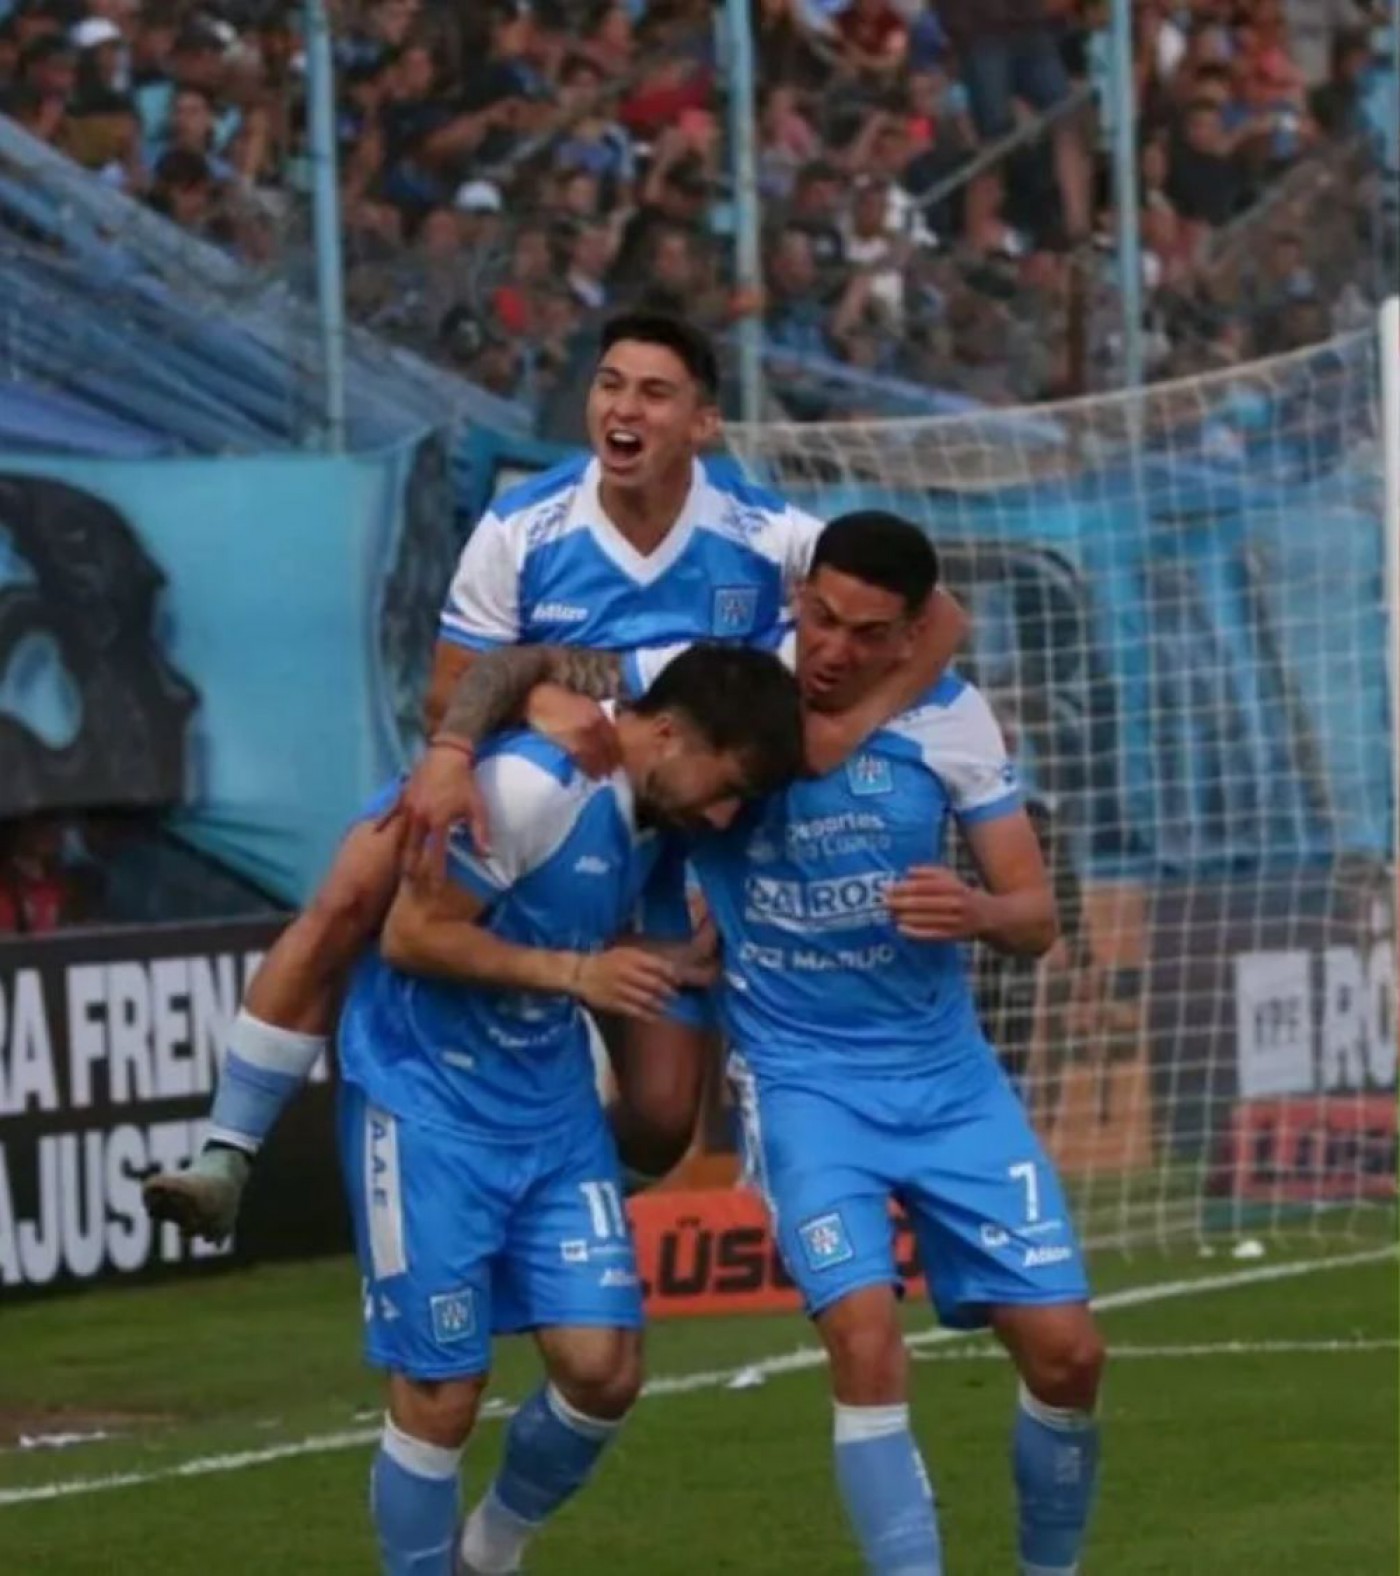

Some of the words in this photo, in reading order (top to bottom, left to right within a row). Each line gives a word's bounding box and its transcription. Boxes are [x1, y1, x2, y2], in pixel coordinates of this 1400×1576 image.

[67, 950, 330, 1108] FREN
[579, 1181, 626, 1238] 11
[1009, 1161, 1038, 1222] 7
